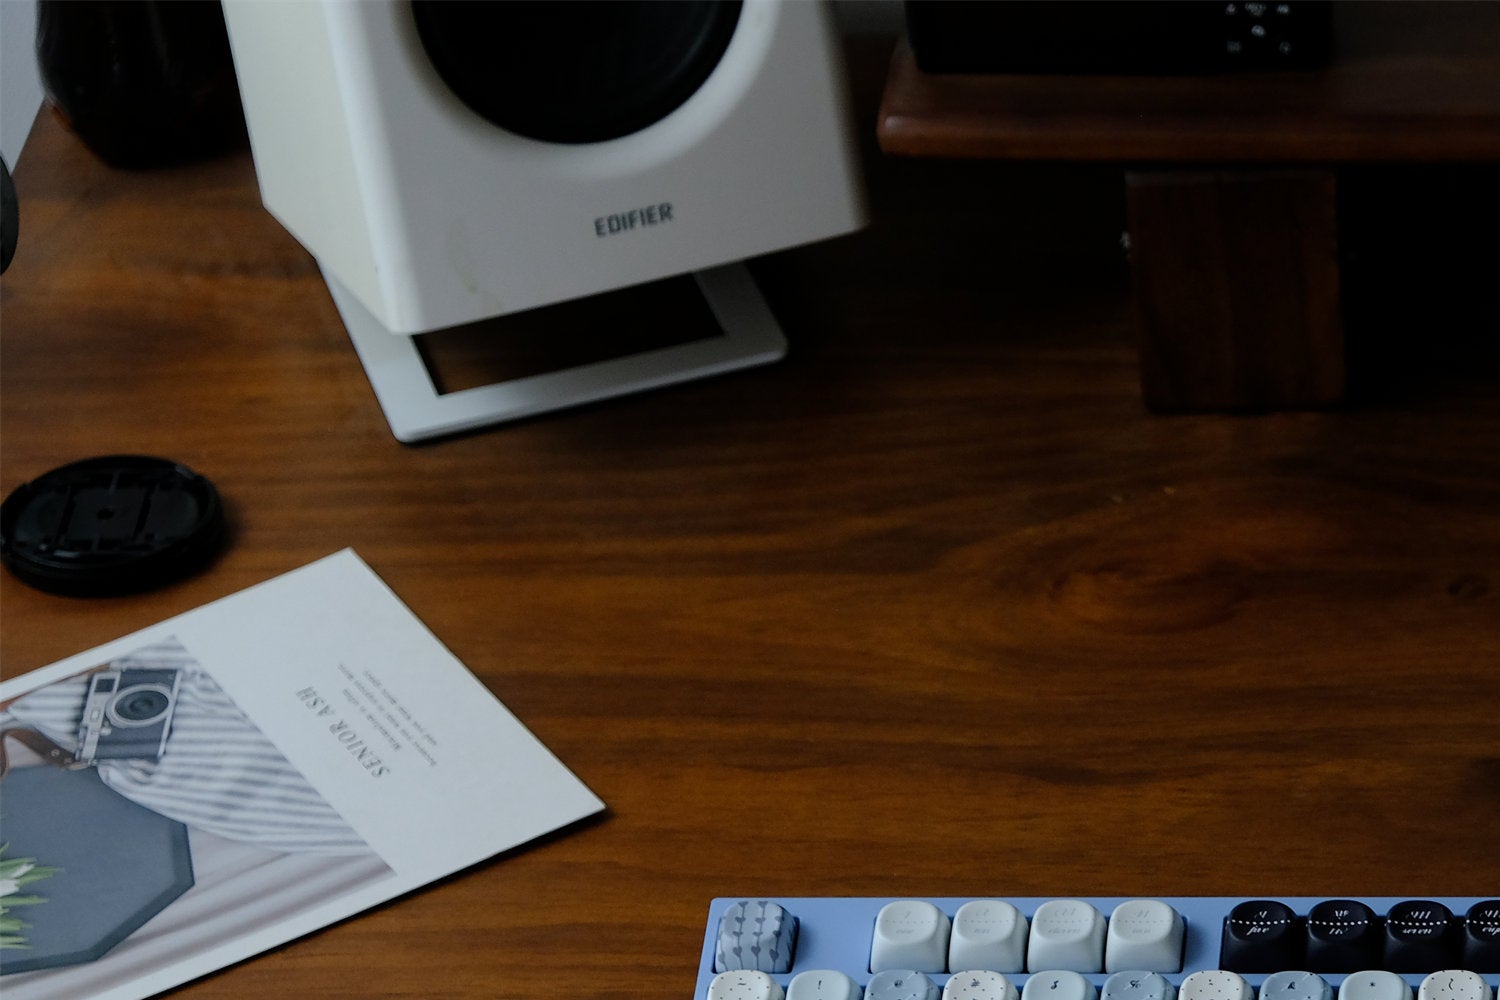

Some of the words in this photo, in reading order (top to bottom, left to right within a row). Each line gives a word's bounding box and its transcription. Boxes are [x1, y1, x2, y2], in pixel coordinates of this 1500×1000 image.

[594, 202, 673, 237] EDIFIER
[296, 686, 335, 717] ASH
[328, 720, 391, 778] SENIOR
